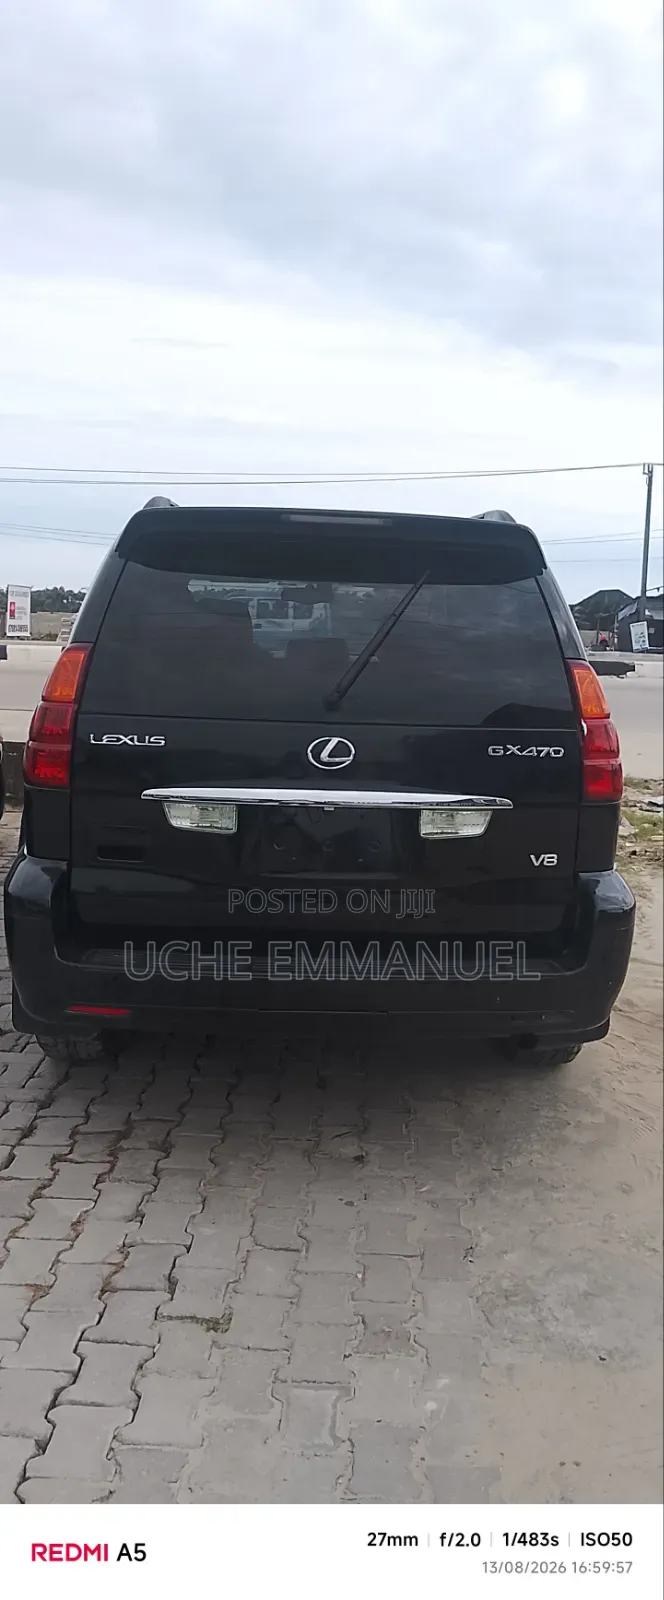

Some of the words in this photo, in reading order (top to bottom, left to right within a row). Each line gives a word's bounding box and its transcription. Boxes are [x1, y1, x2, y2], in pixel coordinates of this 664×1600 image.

[89, 733, 166, 747] LEXUS
[487, 744, 565, 758] GX470
[529, 853, 558, 867] V8
